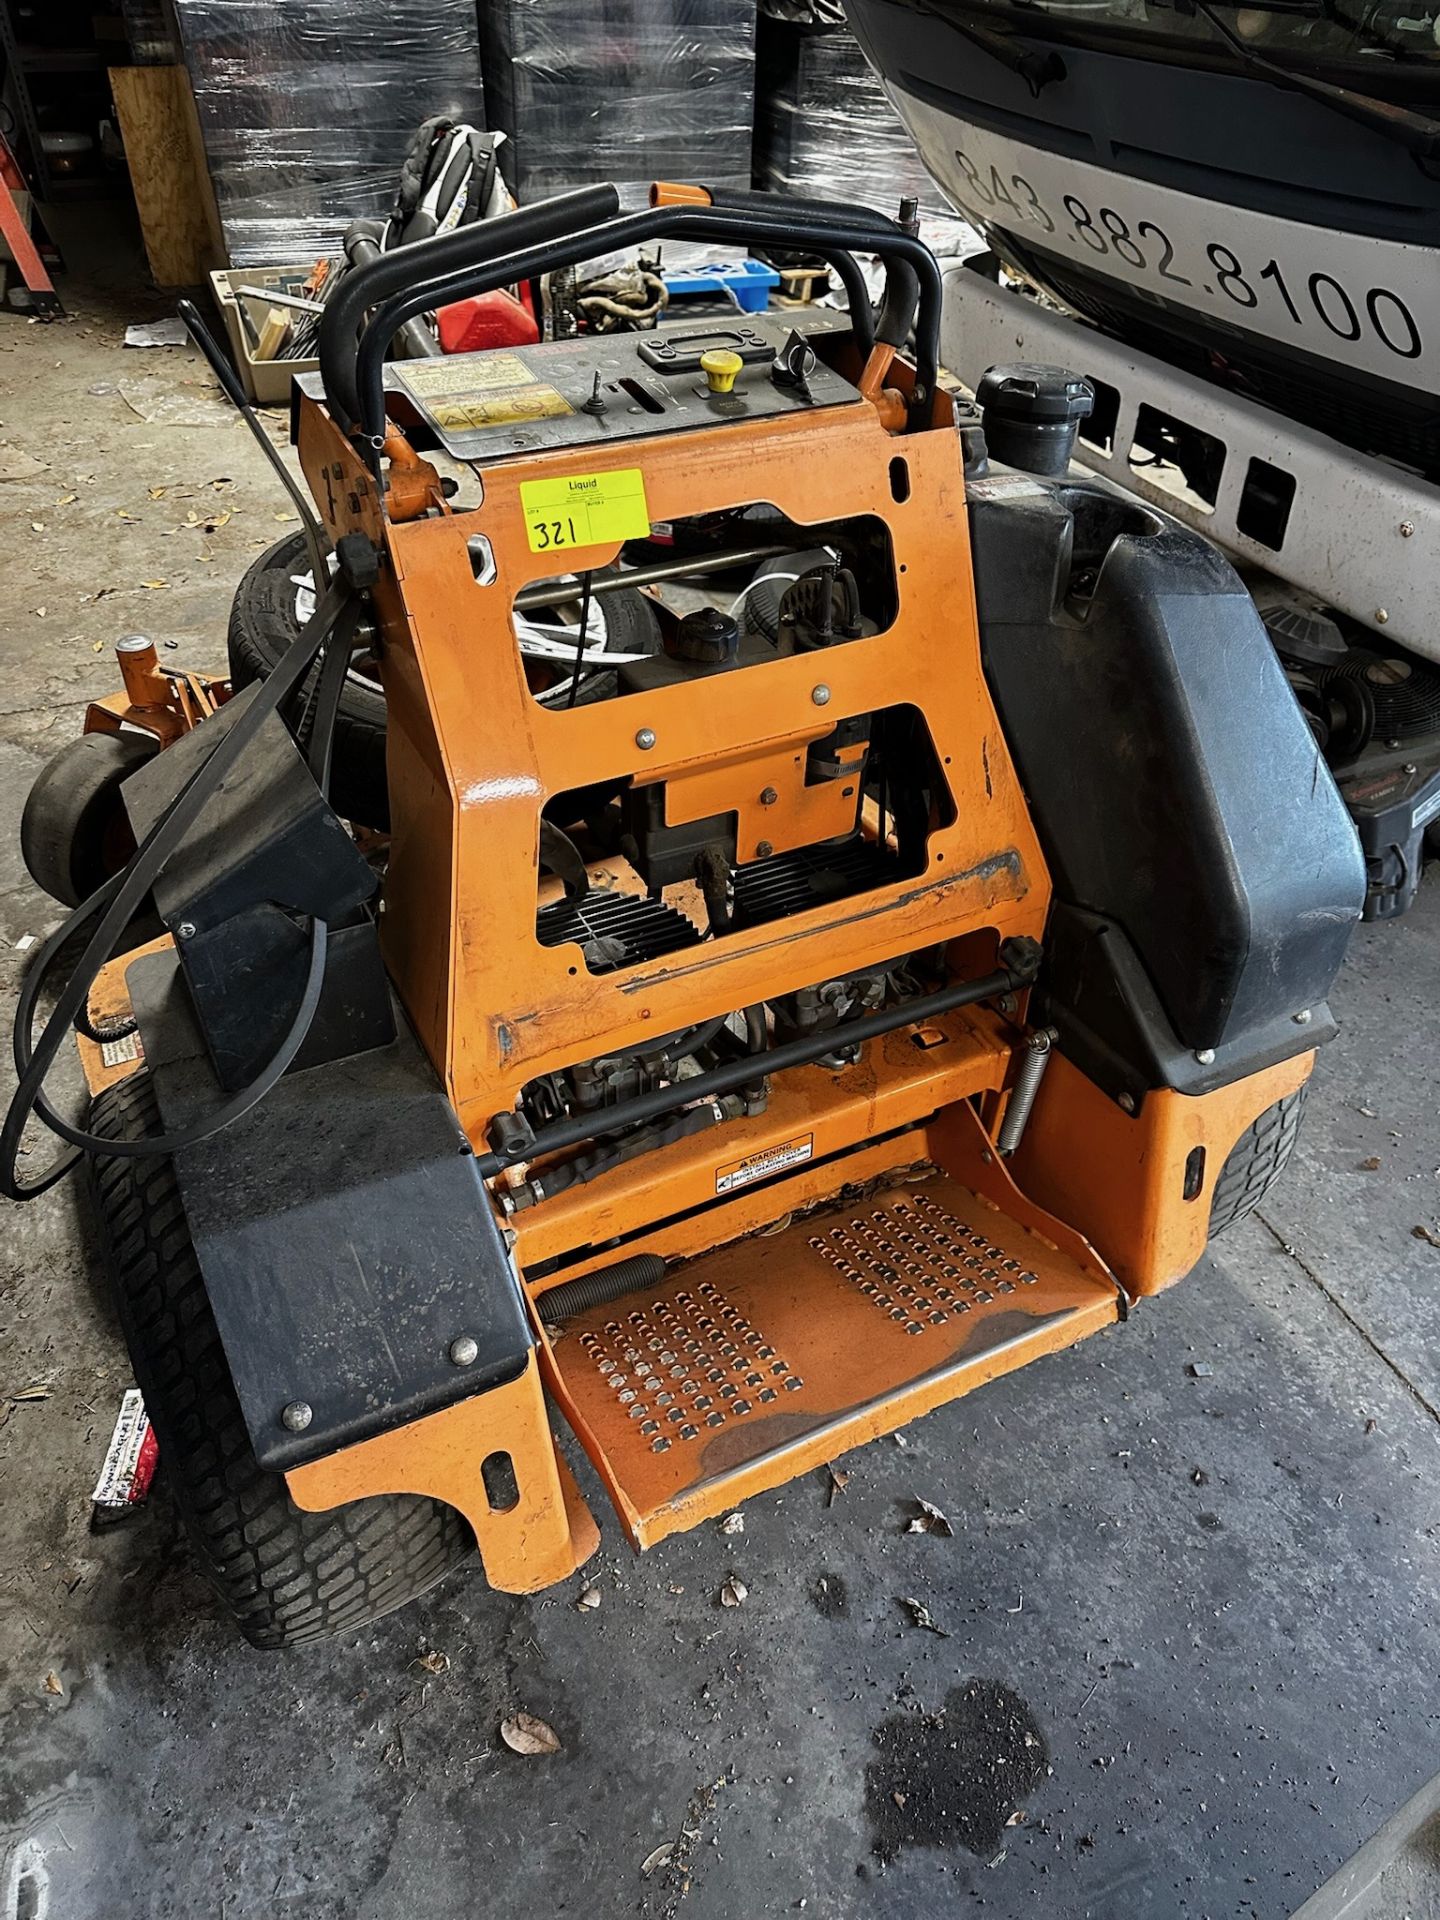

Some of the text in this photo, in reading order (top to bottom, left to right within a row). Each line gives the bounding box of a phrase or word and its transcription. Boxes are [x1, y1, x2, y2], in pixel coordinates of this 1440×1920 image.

[955, 150, 1422, 359] 843.882.8100
[568, 478, 598, 491] Liquid
[533, 517, 576, 548] 321
[732, 1170, 754, 1182] BEFORE
[755, 1158, 785, 1174] OPERATING
[786, 1148, 810, 1160] MACHINE
[749, 1143, 793, 1163] WARNING
